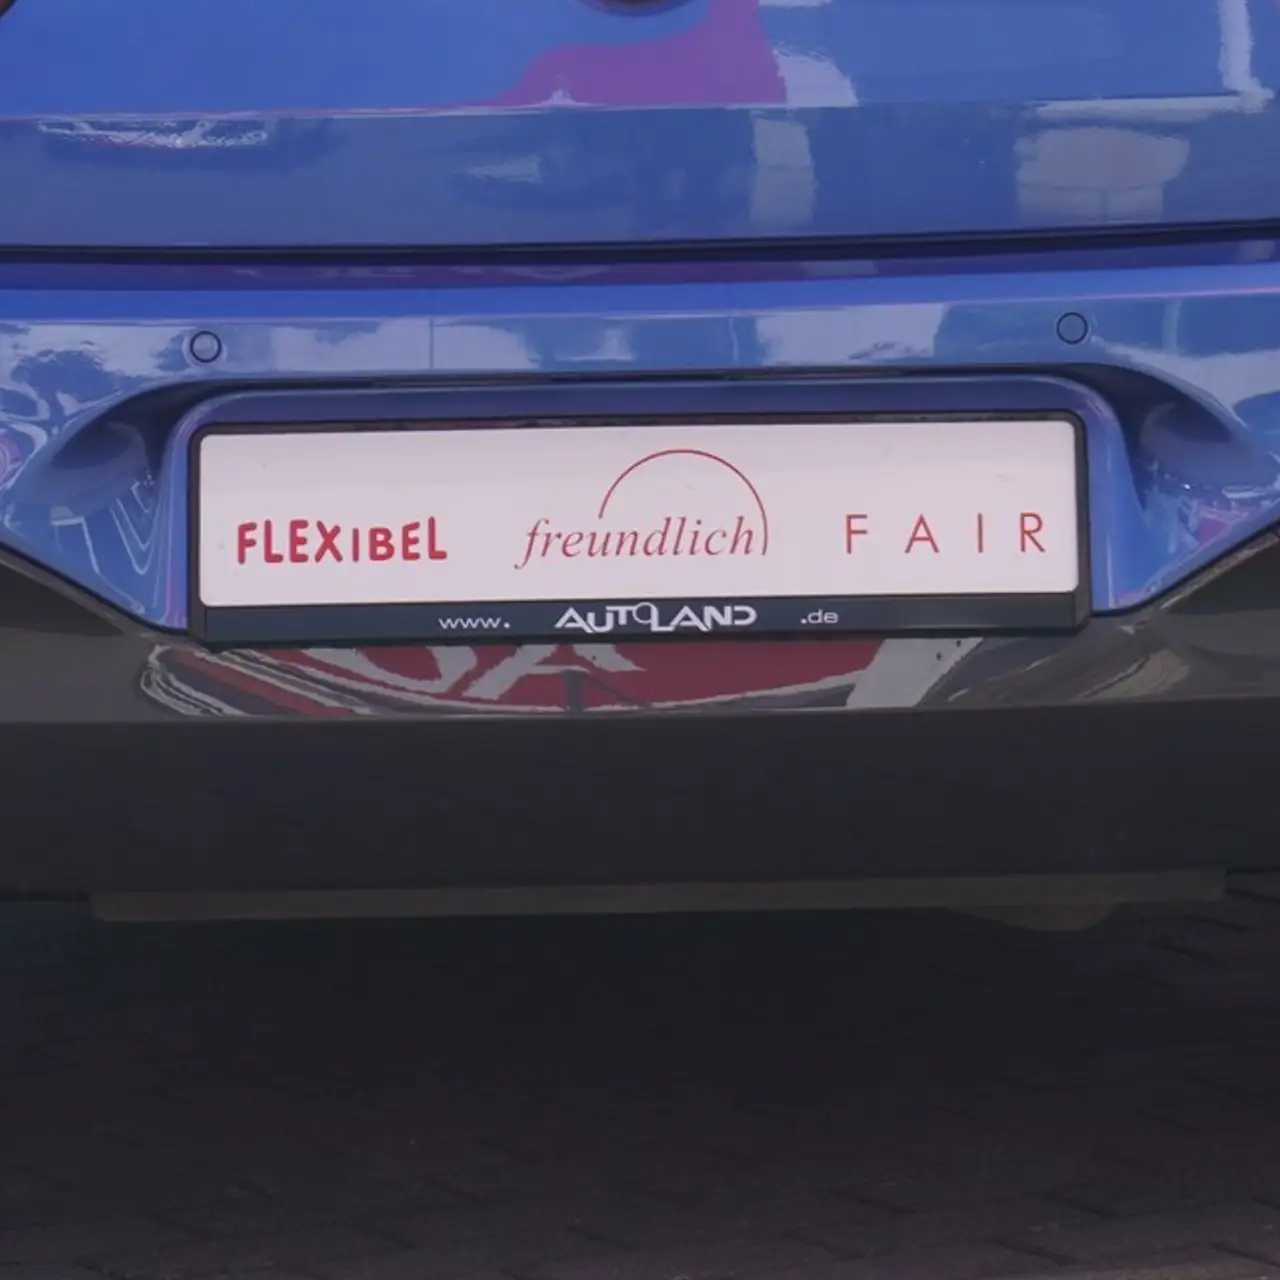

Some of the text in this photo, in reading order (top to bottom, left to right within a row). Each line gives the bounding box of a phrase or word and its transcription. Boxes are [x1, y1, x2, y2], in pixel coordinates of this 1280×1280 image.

[236, 511, 1046, 570] FLEXIBEL freundlich FAIR
[438, 601, 839, 633] www. AUTOLAND .de
